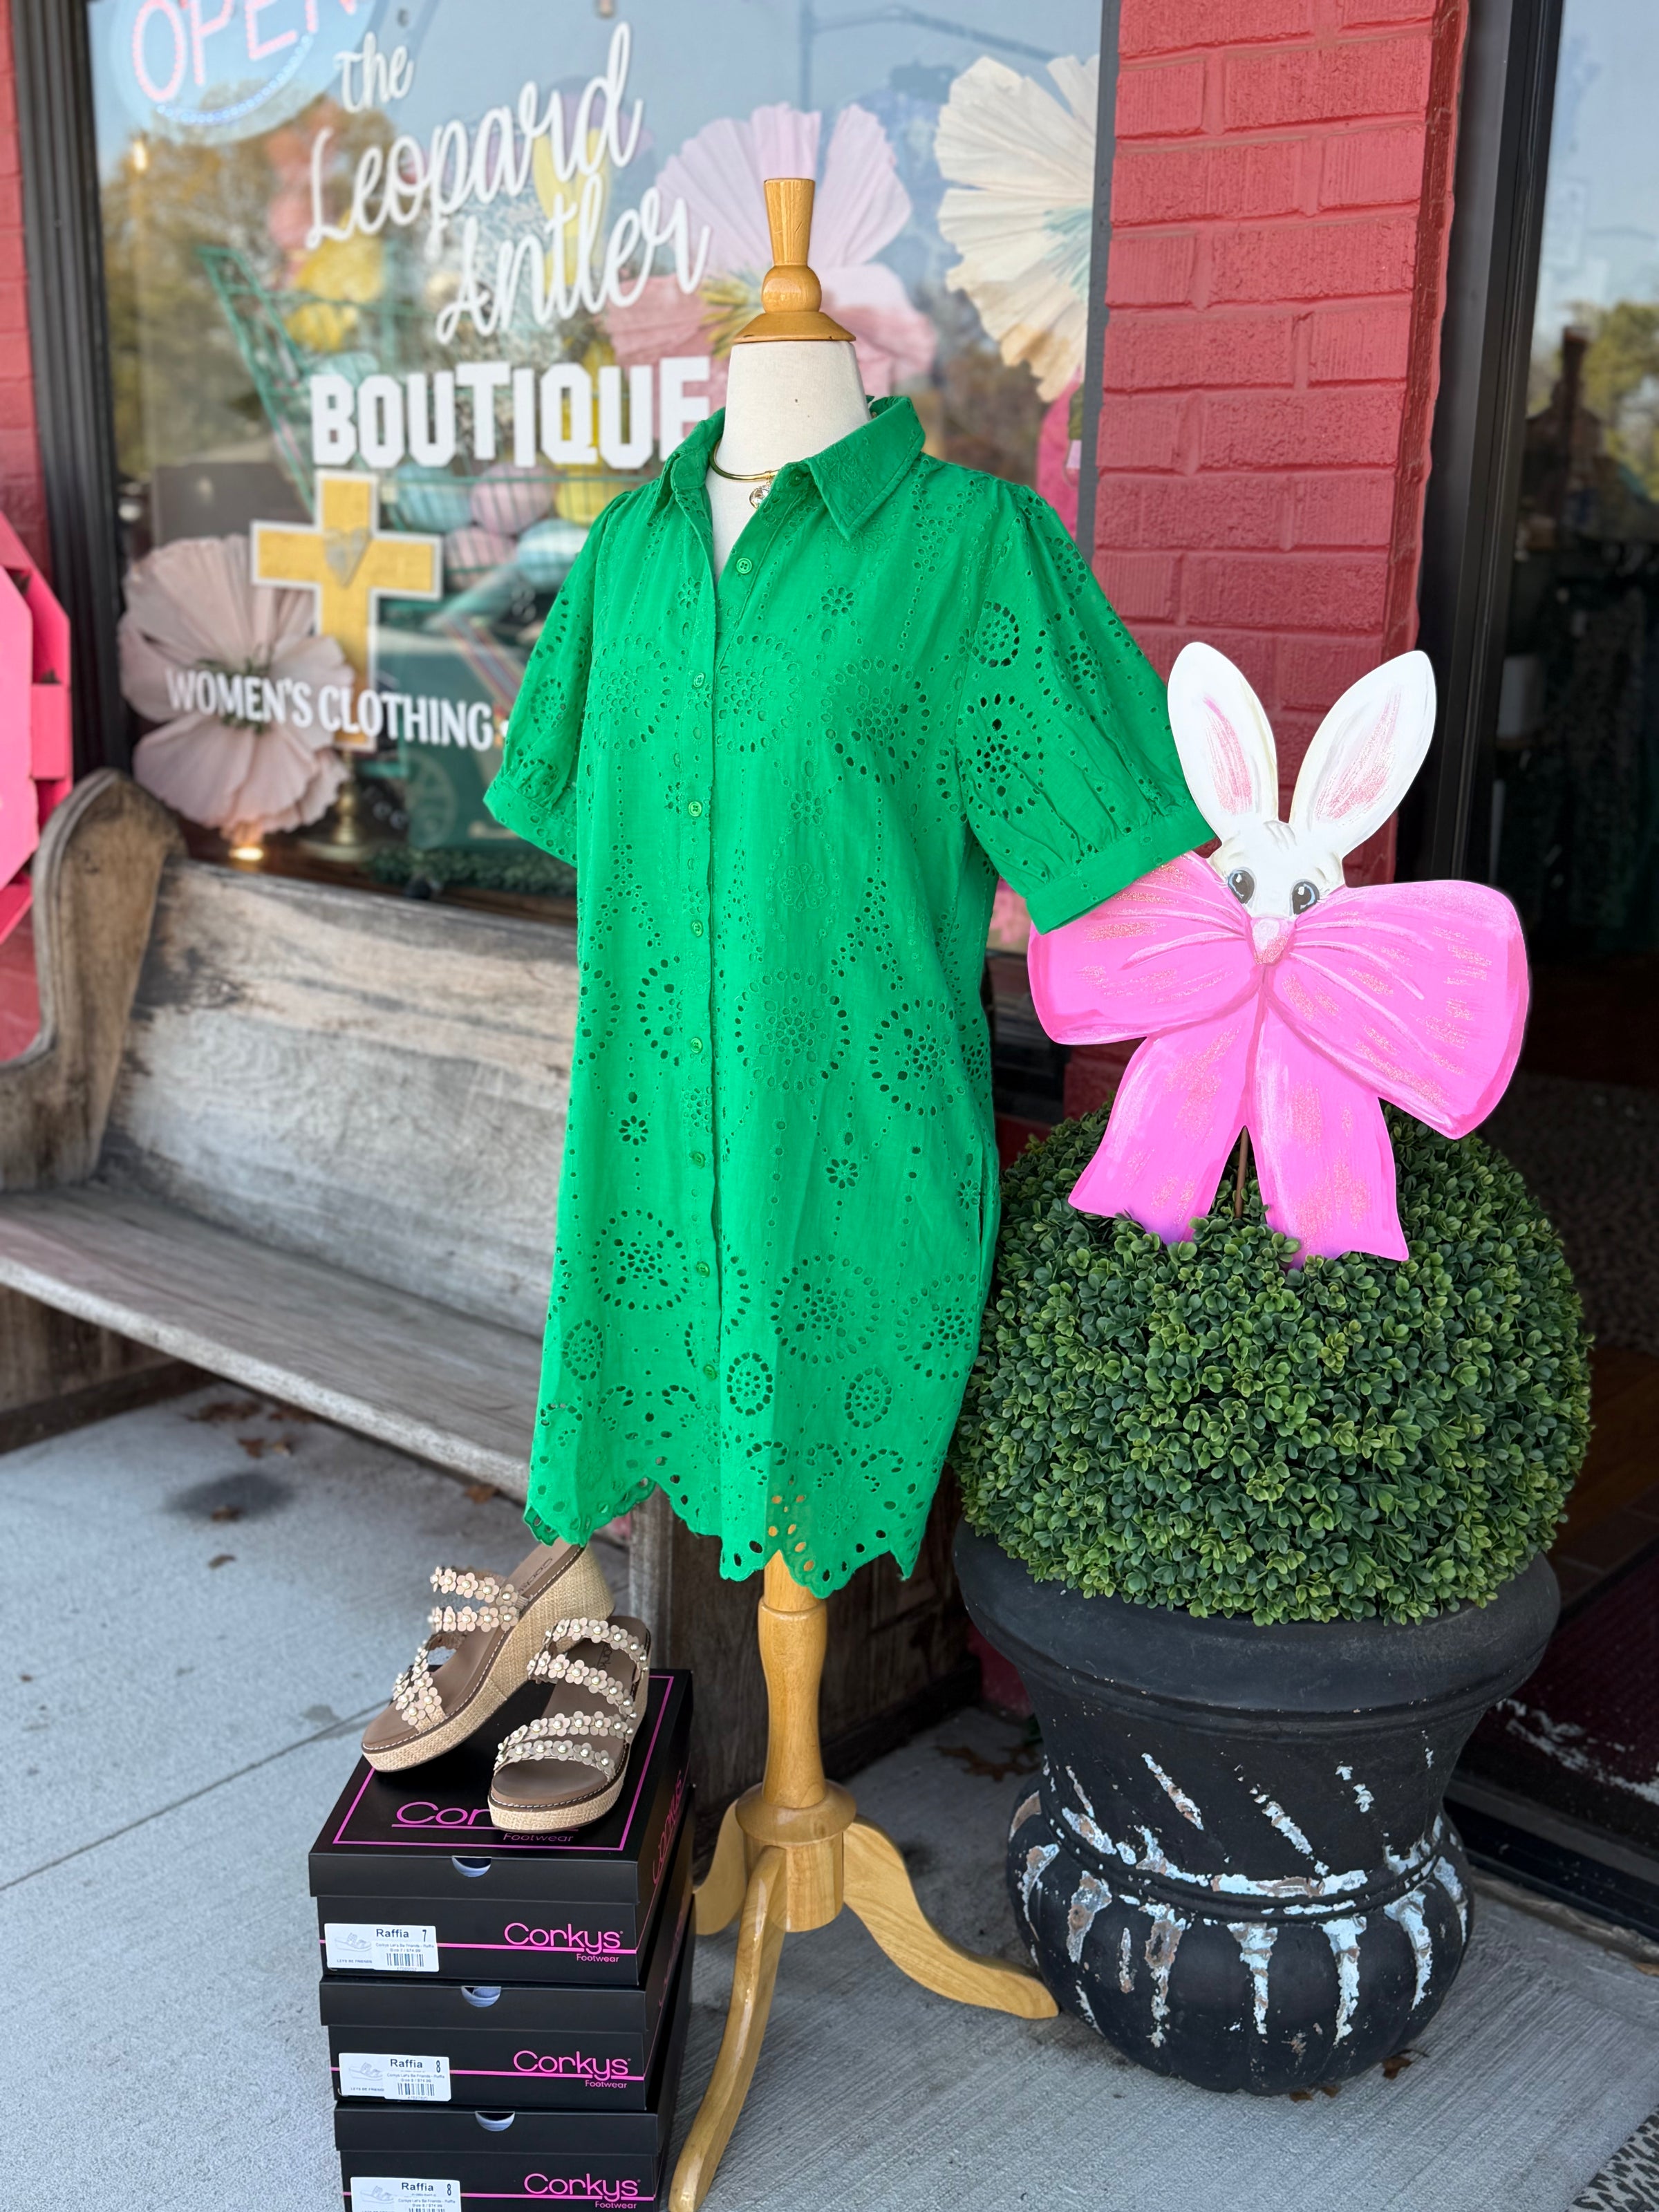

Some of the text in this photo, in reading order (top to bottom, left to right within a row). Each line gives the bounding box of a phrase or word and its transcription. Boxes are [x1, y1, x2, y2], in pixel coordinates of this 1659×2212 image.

[305, 22, 643, 259] Leopard
[435, 171, 711, 346] Antler
[310, 355, 711, 469] BOUTIQUE
[165, 666, 494, 751] WOMEN'S CLOTHING
[503, 1833, 574, 1842] Footwear
[376, 1929, 427, 1942] Raffia 7
[504, 1922, 621, 1955] Corkys
[576, 1953, 619, 1962] Footwear
[390, 2059, 441, 2073] Raffia 8
[513, 2050, 628, 2081] Corkys
[585, 2080, 628, 2088] Footwear
[401, 2182, 452, 2196] Raffia 8
[524, 2173, 639, 2202] Corkys
[594, 2201, 637, 2209] Footwear
